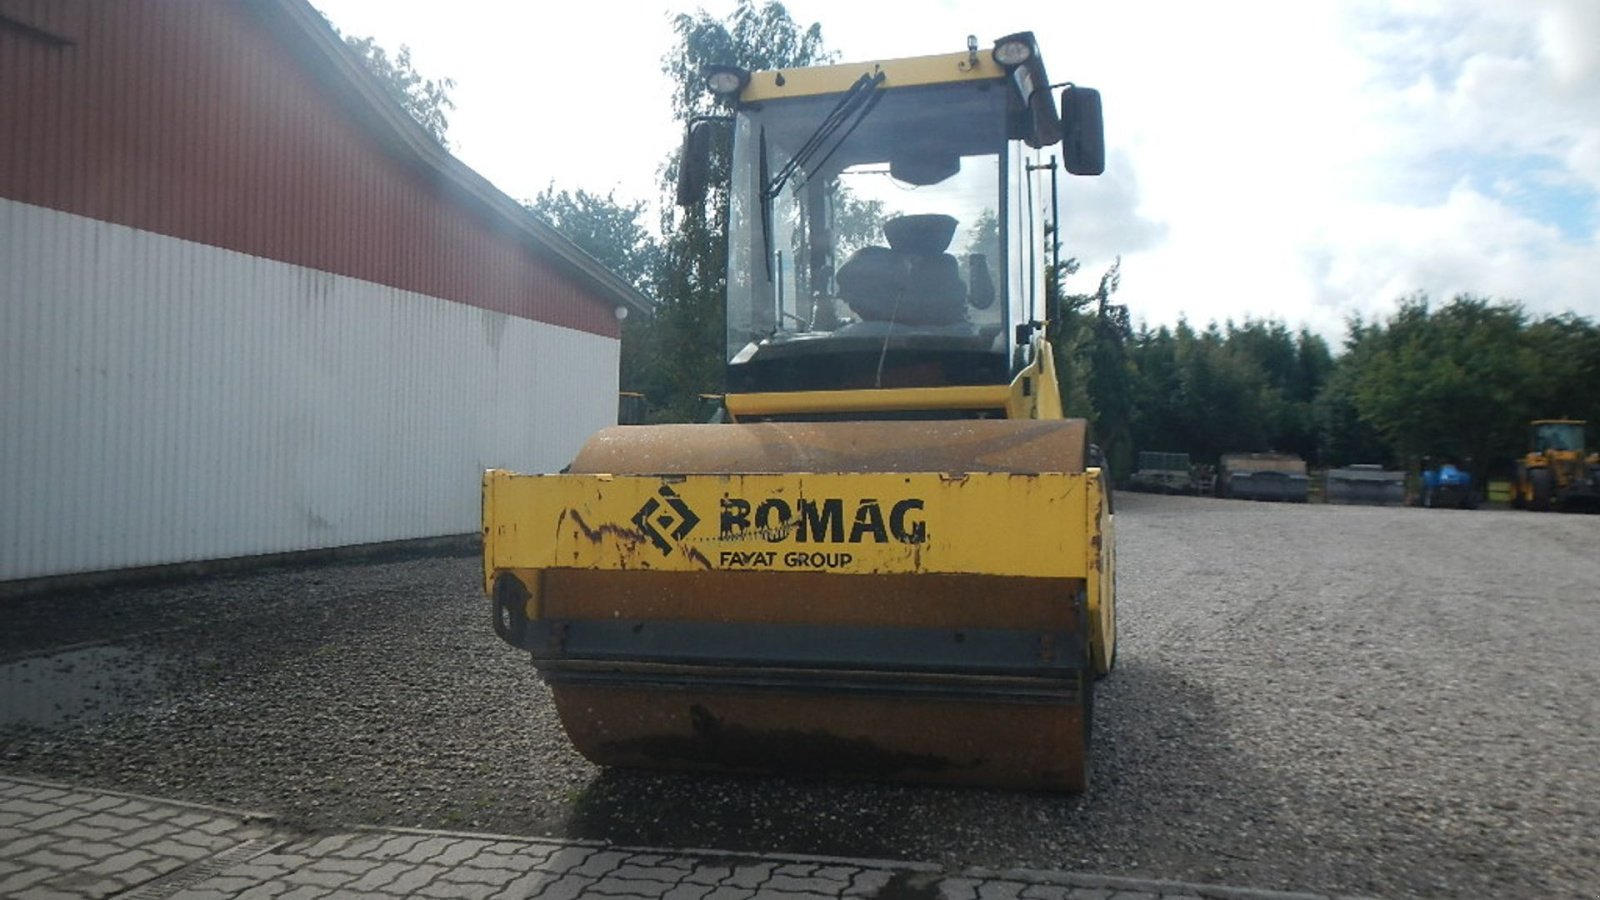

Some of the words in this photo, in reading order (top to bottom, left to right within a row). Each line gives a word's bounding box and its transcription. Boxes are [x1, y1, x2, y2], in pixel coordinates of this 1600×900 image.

[720, 498, 926, 544] BOMAG
[720, 552, 777, 567] FAYAT
[784, 552, 852, 568] GROUP
